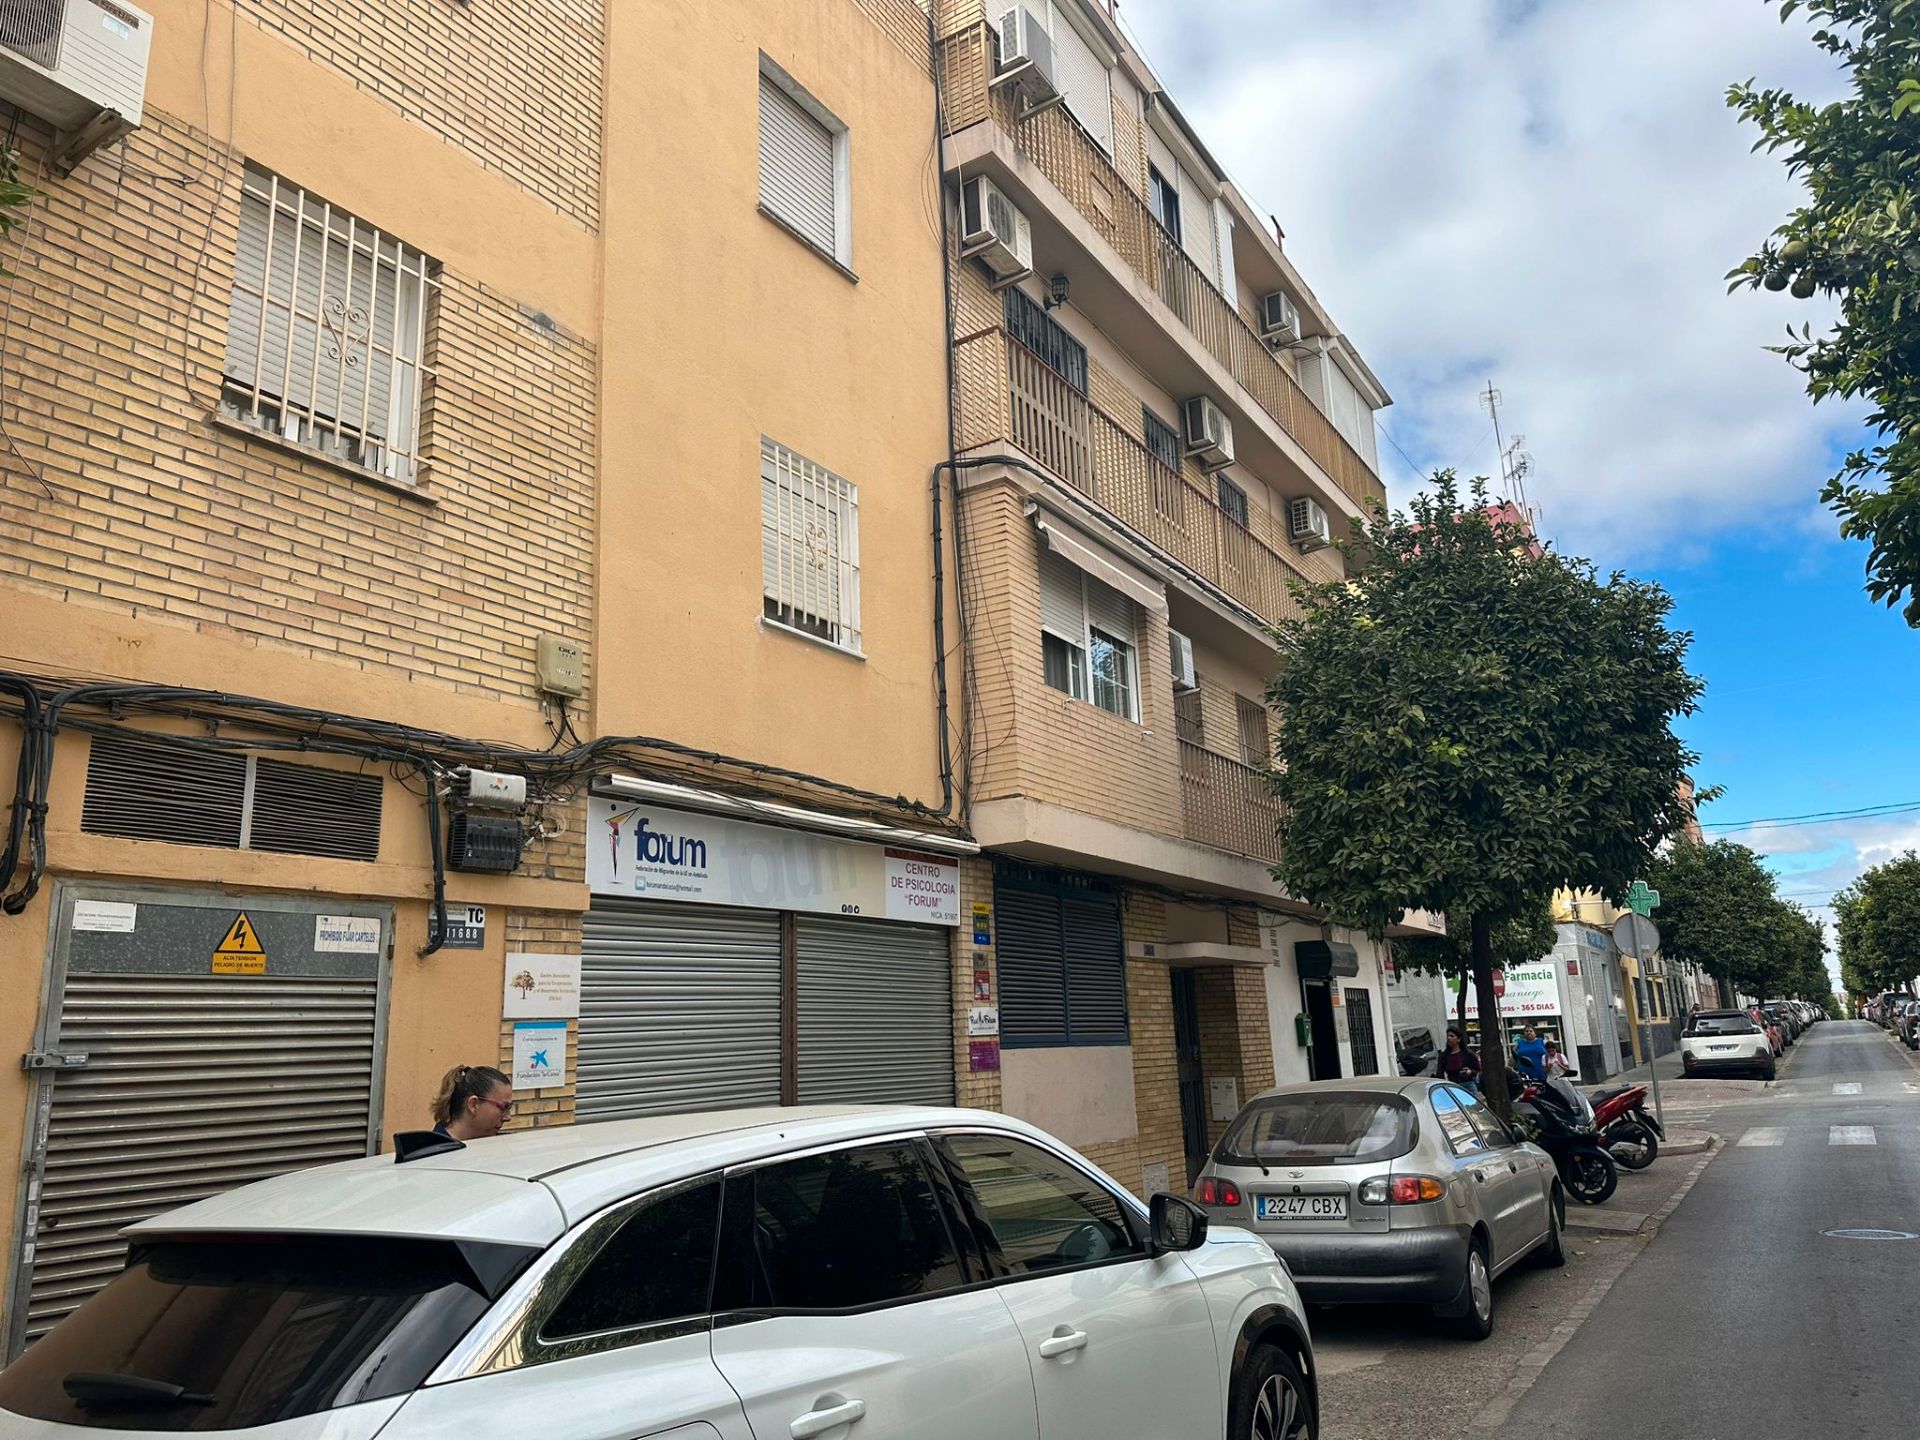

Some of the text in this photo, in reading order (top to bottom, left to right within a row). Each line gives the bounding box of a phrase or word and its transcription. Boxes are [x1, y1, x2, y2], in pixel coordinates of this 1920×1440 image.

[634, 817, 707, 869] forum
[905, 862, 940, 878] CENTRO
[891, 876, 956, 895] DE PSICOLOGIA
[467, 907, 484, 924] TC
[320, 930, 342, 941] PROHIBIDO
[355, 931, 375, 943] CARTELES
[1503, 969, 1553, 982] Farmacia
[1521, 1003, 1536, 1011] 365
[1268, 1199, 1305, 1214] 2247
[1312, 1198, 1342, 1213] CBX
